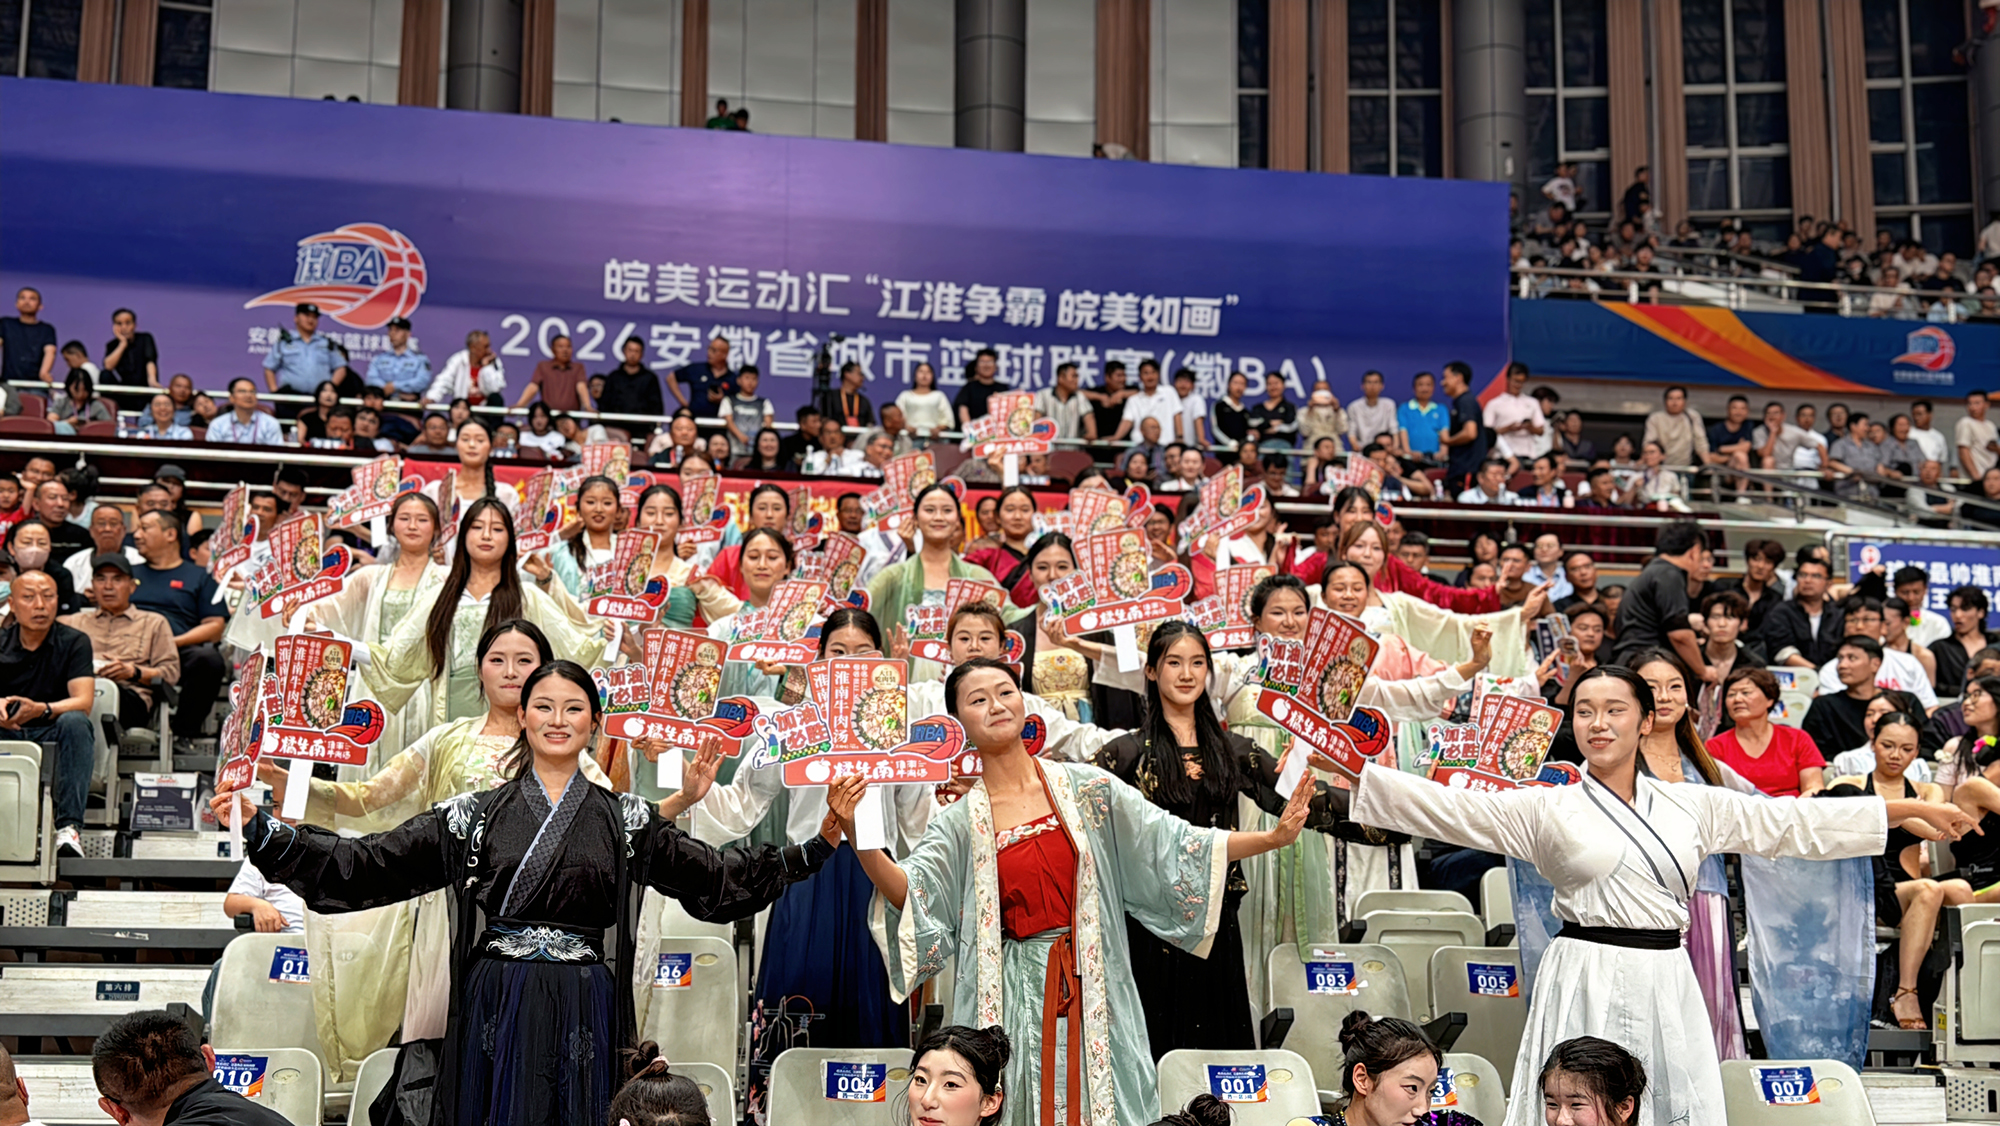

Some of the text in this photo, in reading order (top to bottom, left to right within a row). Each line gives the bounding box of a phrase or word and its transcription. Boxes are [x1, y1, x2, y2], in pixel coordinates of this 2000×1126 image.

[604, 258, 850, 316] 皖美运动汇
[1271, 641, 1302, 665] 加油
[609, 667, 645, 687] 加油
[651, 640, 679, 707] 淮南牛肉汤
[1271, 662, 1301, 686] 必胜
[614, 685, 650, 705] 必胜
[833, 671, 850, 743] 淮南牛肉汤
[776, 703, 819, 733] 加油
[787, 720, 829, 751] 必胜
[1443, 725, 1478, 743] 加油
[1445, 742, 1480, 760] 必胜
[282, 960, 310, 973] 01
[105, 983, 132, 992] 第六排
[1316, 973, 1347, 987] 003
[1477, 975, 1508, 989] 005
[212, 1070, 252, 1087] 010
[838, 1077, 875, 1092] 004
[1221, 1078, 1255, 1094] 001
[1771, 1080, 1805, 1096] 007
